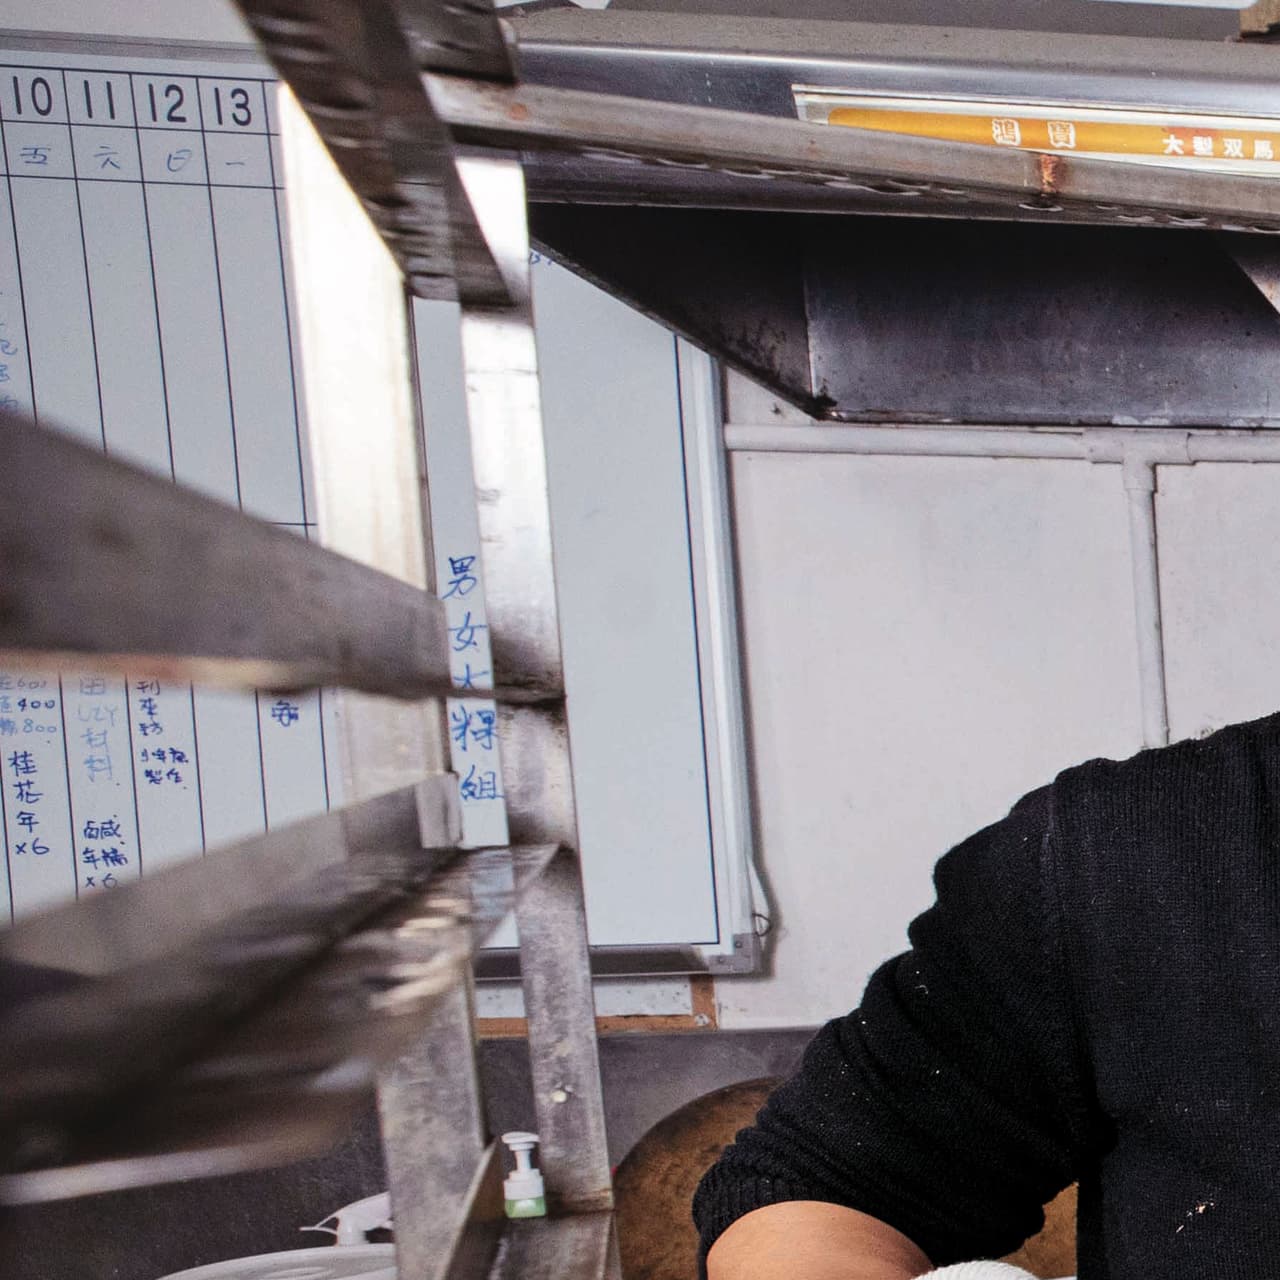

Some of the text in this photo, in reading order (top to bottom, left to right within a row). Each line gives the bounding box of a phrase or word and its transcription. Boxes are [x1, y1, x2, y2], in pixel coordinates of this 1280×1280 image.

[13, 76, 251, 126] 10 11 12 13
[94, 146, 120, 169] 六
[167, 149, 192, 172] 日
